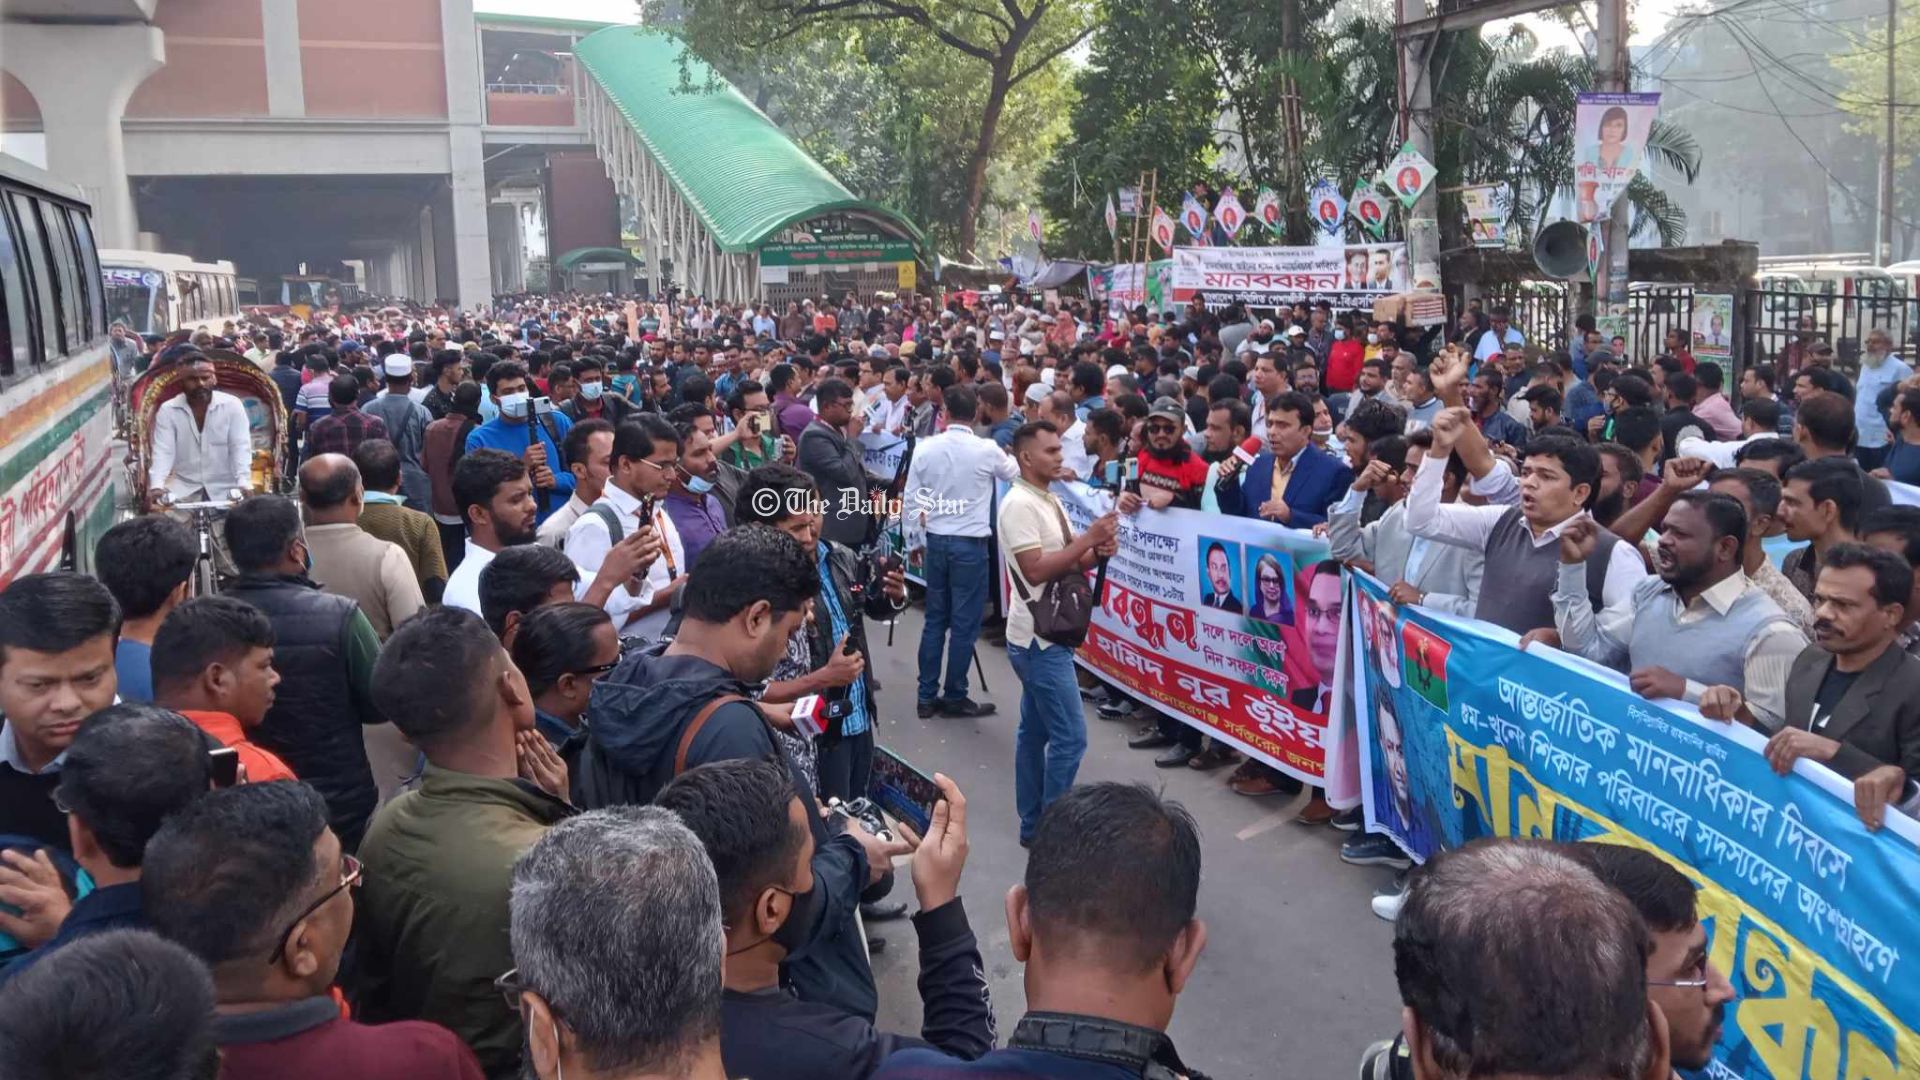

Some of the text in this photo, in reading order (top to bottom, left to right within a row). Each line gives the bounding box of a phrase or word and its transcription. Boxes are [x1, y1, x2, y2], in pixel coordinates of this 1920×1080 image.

[1204, 272, 1341, 290] মানববন্ধন
[1201, 621, 1225, 643] দলে
[1228, 629, 1254, 651] দলে
[1097, 632, 1165, 685] হামিদ
[1203, 646, 1225, 668] নিন
[1227, 655, 1259, 681] সফল
[1498, 675, 1853, 892] আন্তর্জাতিক মানবাধিকার দিবসে
[1529, 729, 1592, 788] শিকার
[1597, 768, 1691, 842] পরিবারের
[1696, 819, 1791, 904] সদস্যদের
[1797, 881, 1900, 984] অংশগ্রহণে
